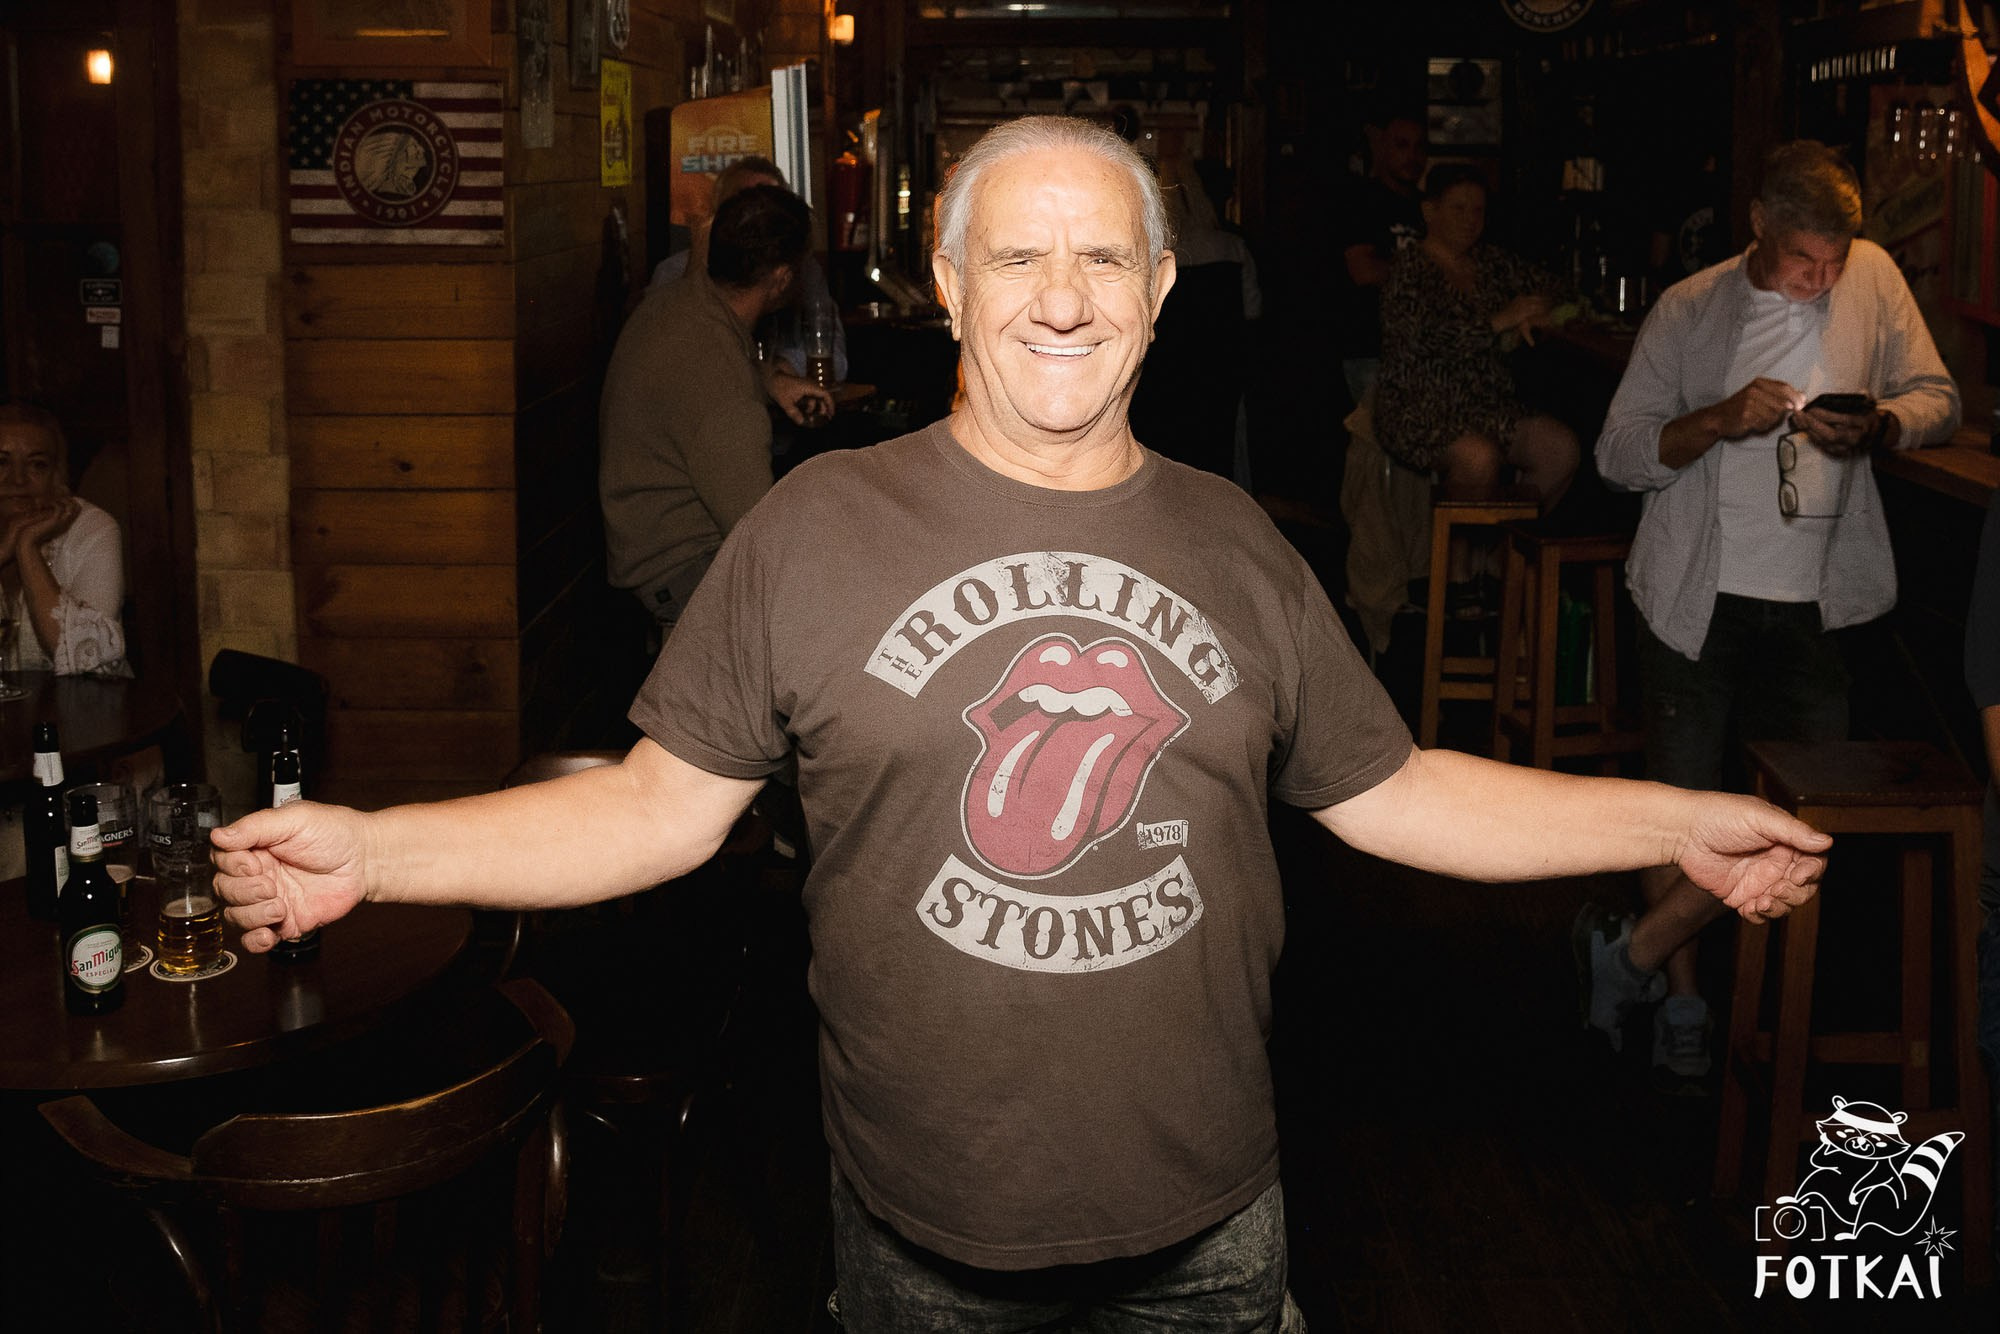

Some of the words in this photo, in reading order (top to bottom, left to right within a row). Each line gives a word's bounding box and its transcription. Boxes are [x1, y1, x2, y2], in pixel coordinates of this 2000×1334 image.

[339, 121, 365, 198] INDIAN
[368, 105, 452, 200] MOTORCYCLE
[687, 134, 761, 153] FIRE
[375, 203, 418, 220] 1901
[895, 561, 1226, 687] ROLLING
[877, 647, 923, 680] THE
[1145, 824, 1182, 844] 1978
[926, 872, 1195, 961] STONES
[85, 967, 117, 978] ESPECIAL
